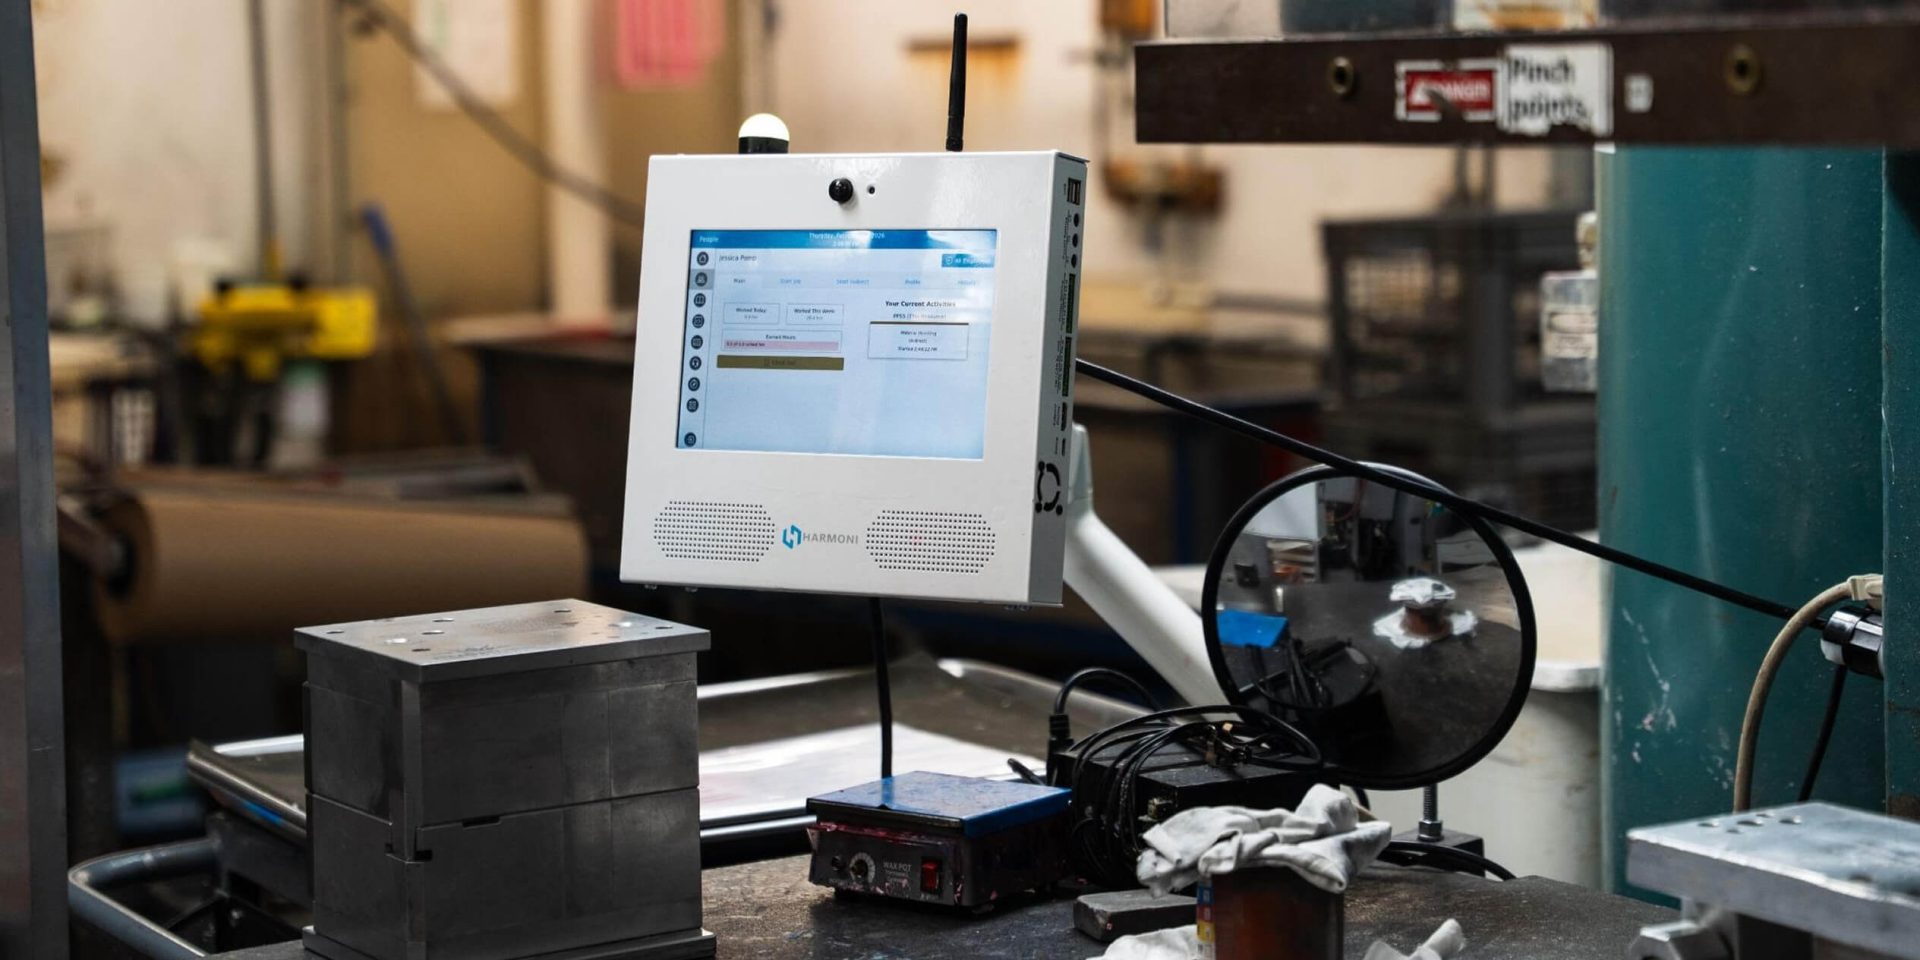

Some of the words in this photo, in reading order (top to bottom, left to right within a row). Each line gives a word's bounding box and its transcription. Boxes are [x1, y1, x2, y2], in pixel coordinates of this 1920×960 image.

[1512, 57, 1575, 84] Pinch
[803, 533, 859, 544] HARMONI
[883, 861, 898, 870] WAX
[898, 862, 912, 872] POT
